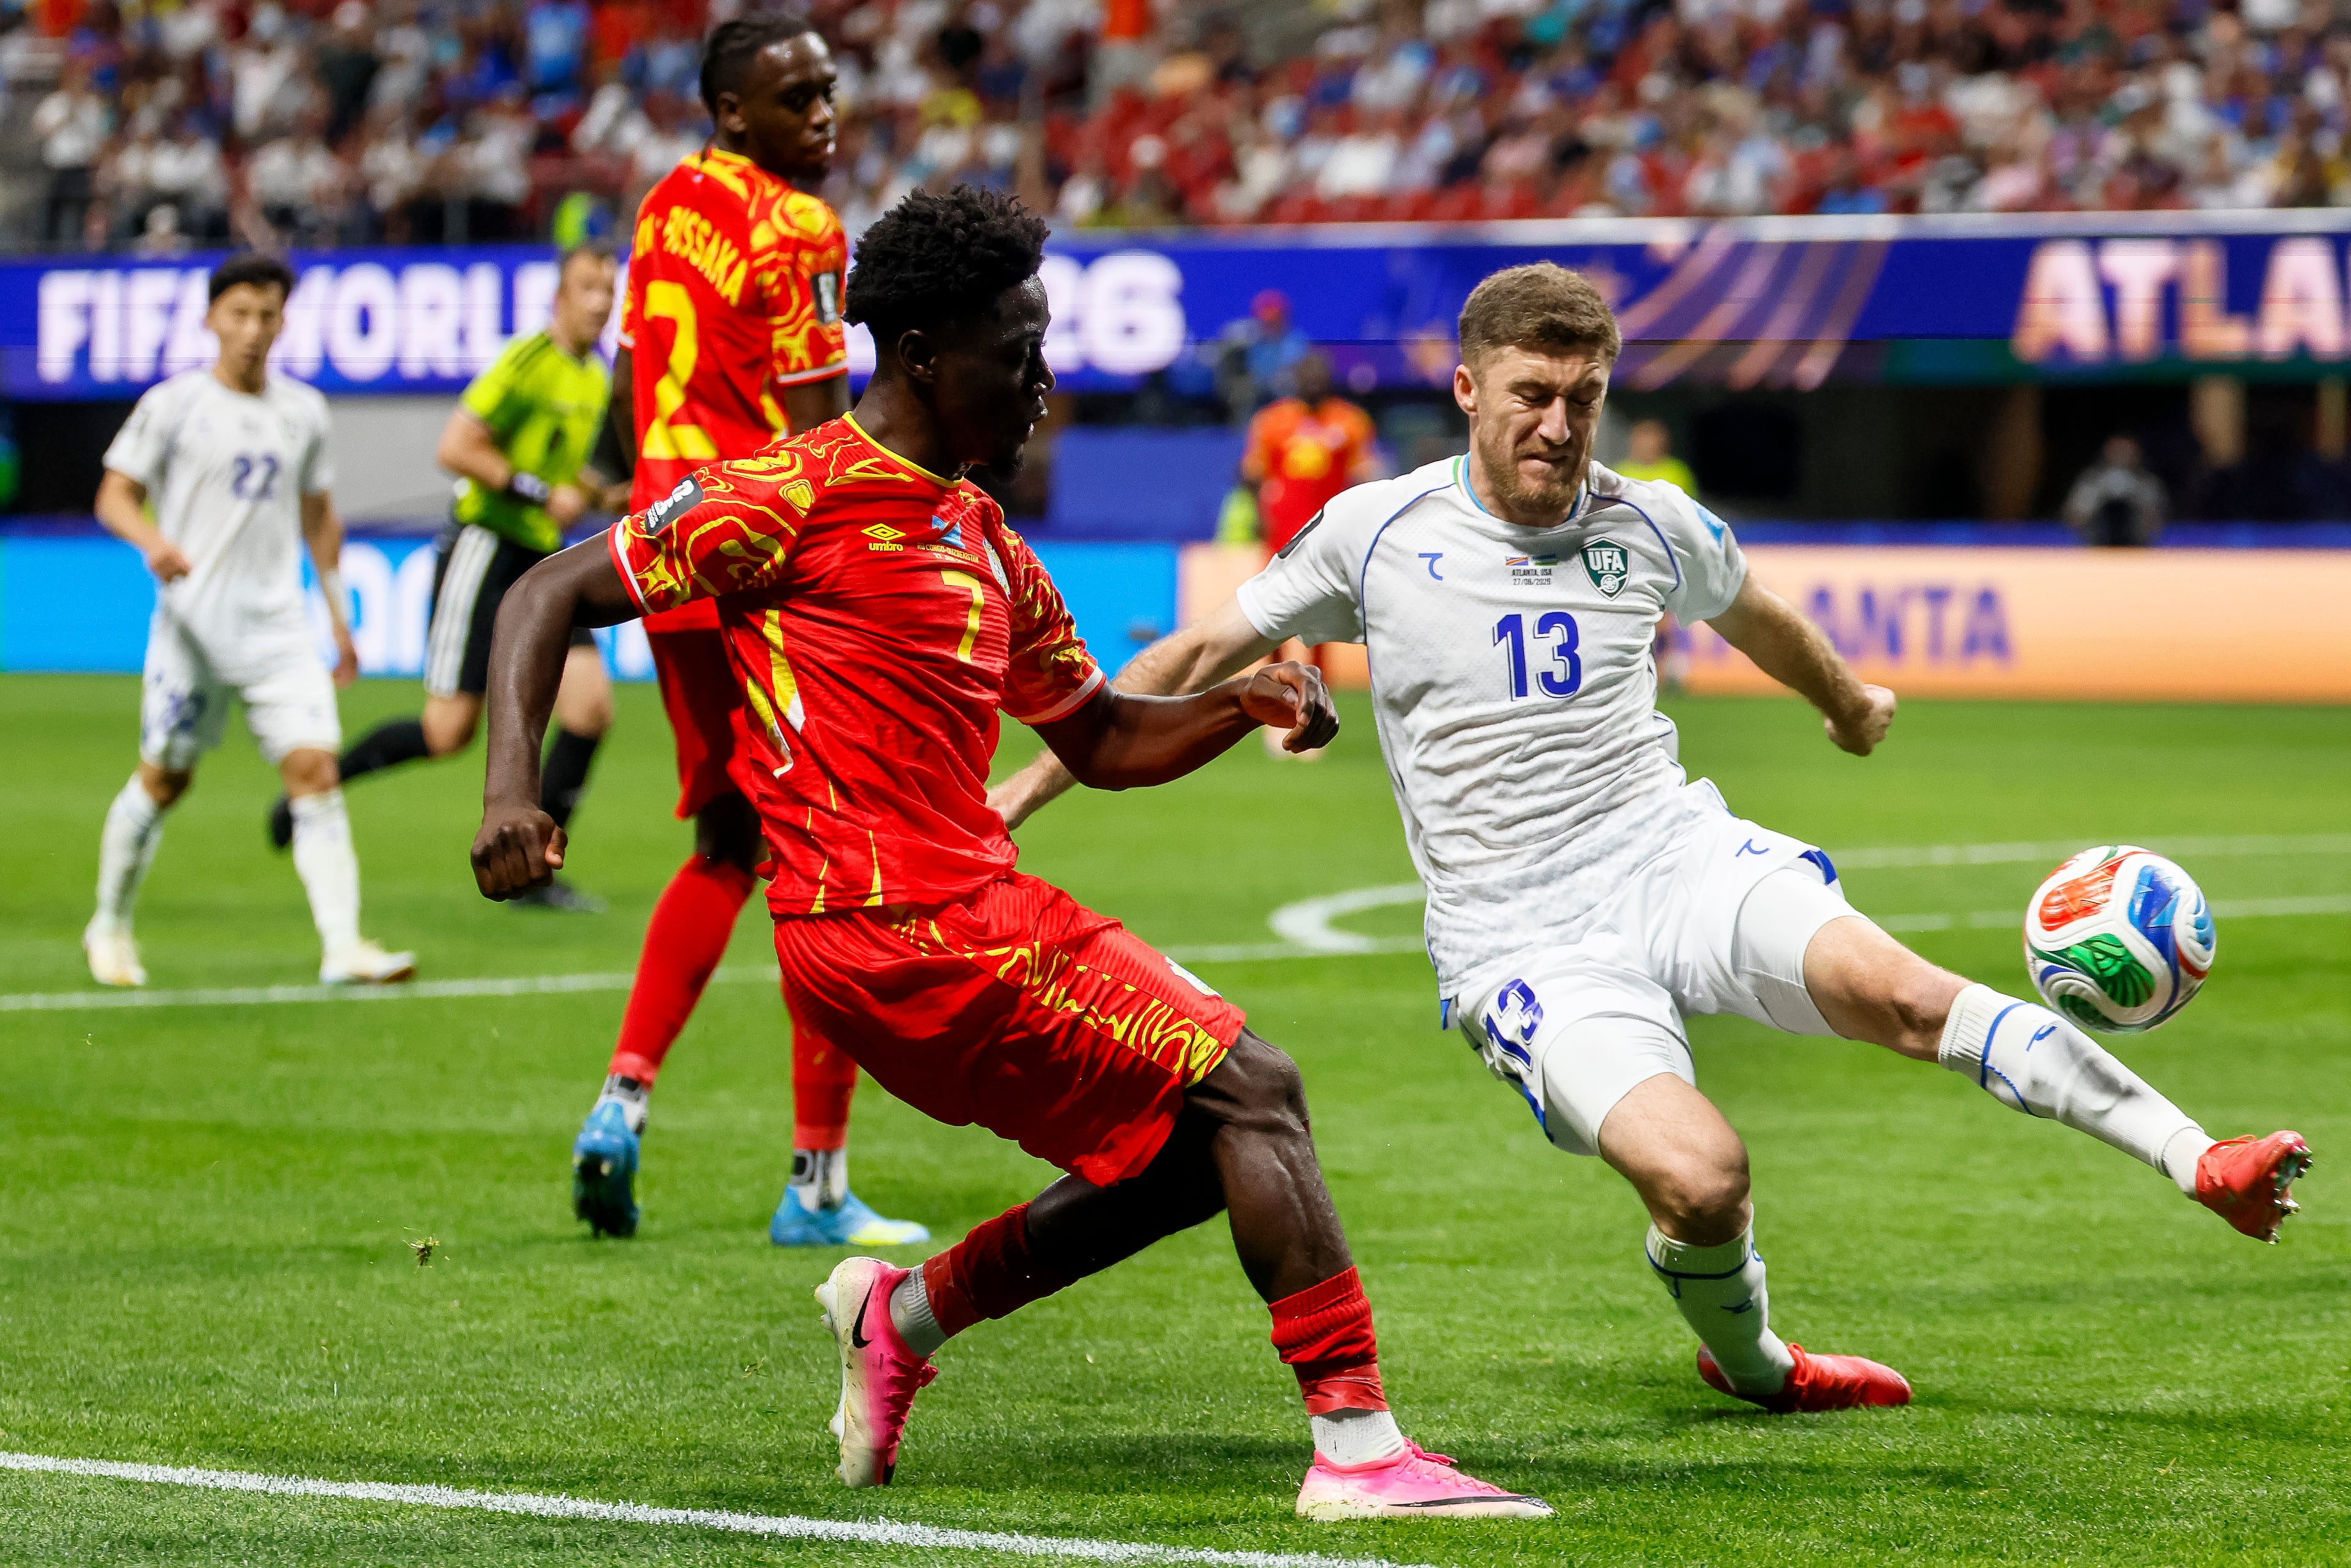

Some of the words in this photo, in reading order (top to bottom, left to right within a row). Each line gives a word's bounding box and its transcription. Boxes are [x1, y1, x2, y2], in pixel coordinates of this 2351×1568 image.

[2011, 238, 2351, 364] ATLA
[643, 280, 718, 459] 2
[231, 452, 282, 501] 22
[868, 541, 904, 551] umbro
[1588, 550, 1625, 571] UFA
[940, 568, 984, 664] 7
[1493, 611, 1581, 701] 13
[1480, 978, 1543, 1071] 13
